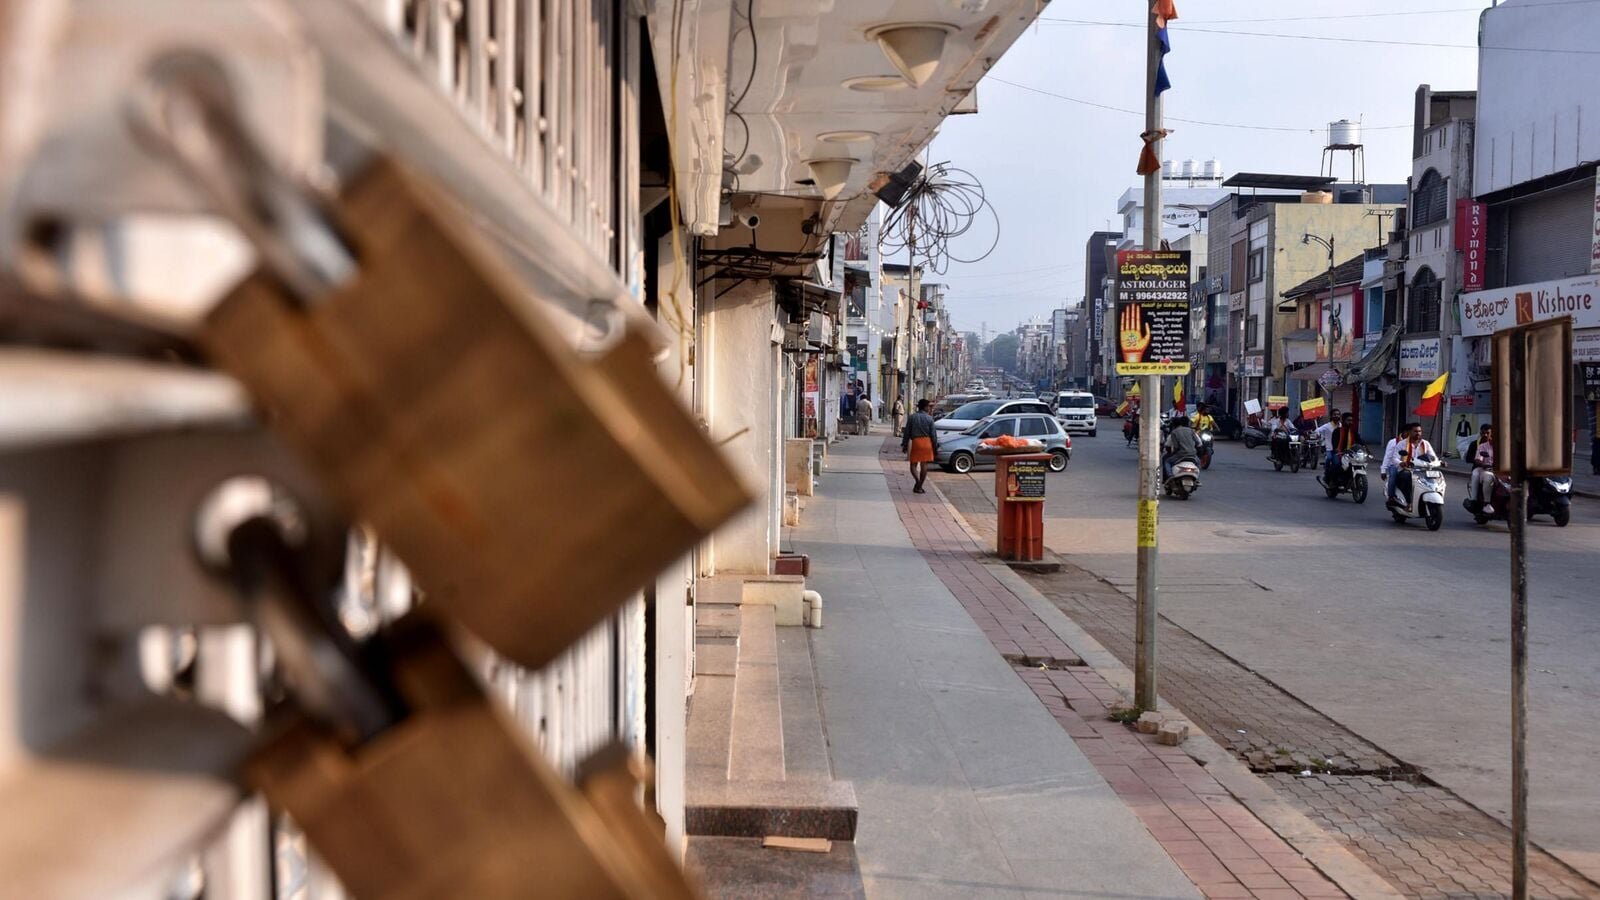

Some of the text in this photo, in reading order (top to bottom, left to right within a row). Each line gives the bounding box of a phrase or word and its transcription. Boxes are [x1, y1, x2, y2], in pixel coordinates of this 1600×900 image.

[1469, 205, 1480, 283] Raymond
[1120, 280, 1186, 289] ASTROLOGER
[1120, 292, 1128, 300] M
[1136, 292, 1187, 300] 9964342922
[1537, 286, 1592, 315] Kishore
[1465, 297, 1509, 319] ಕಿಶೋರ್
